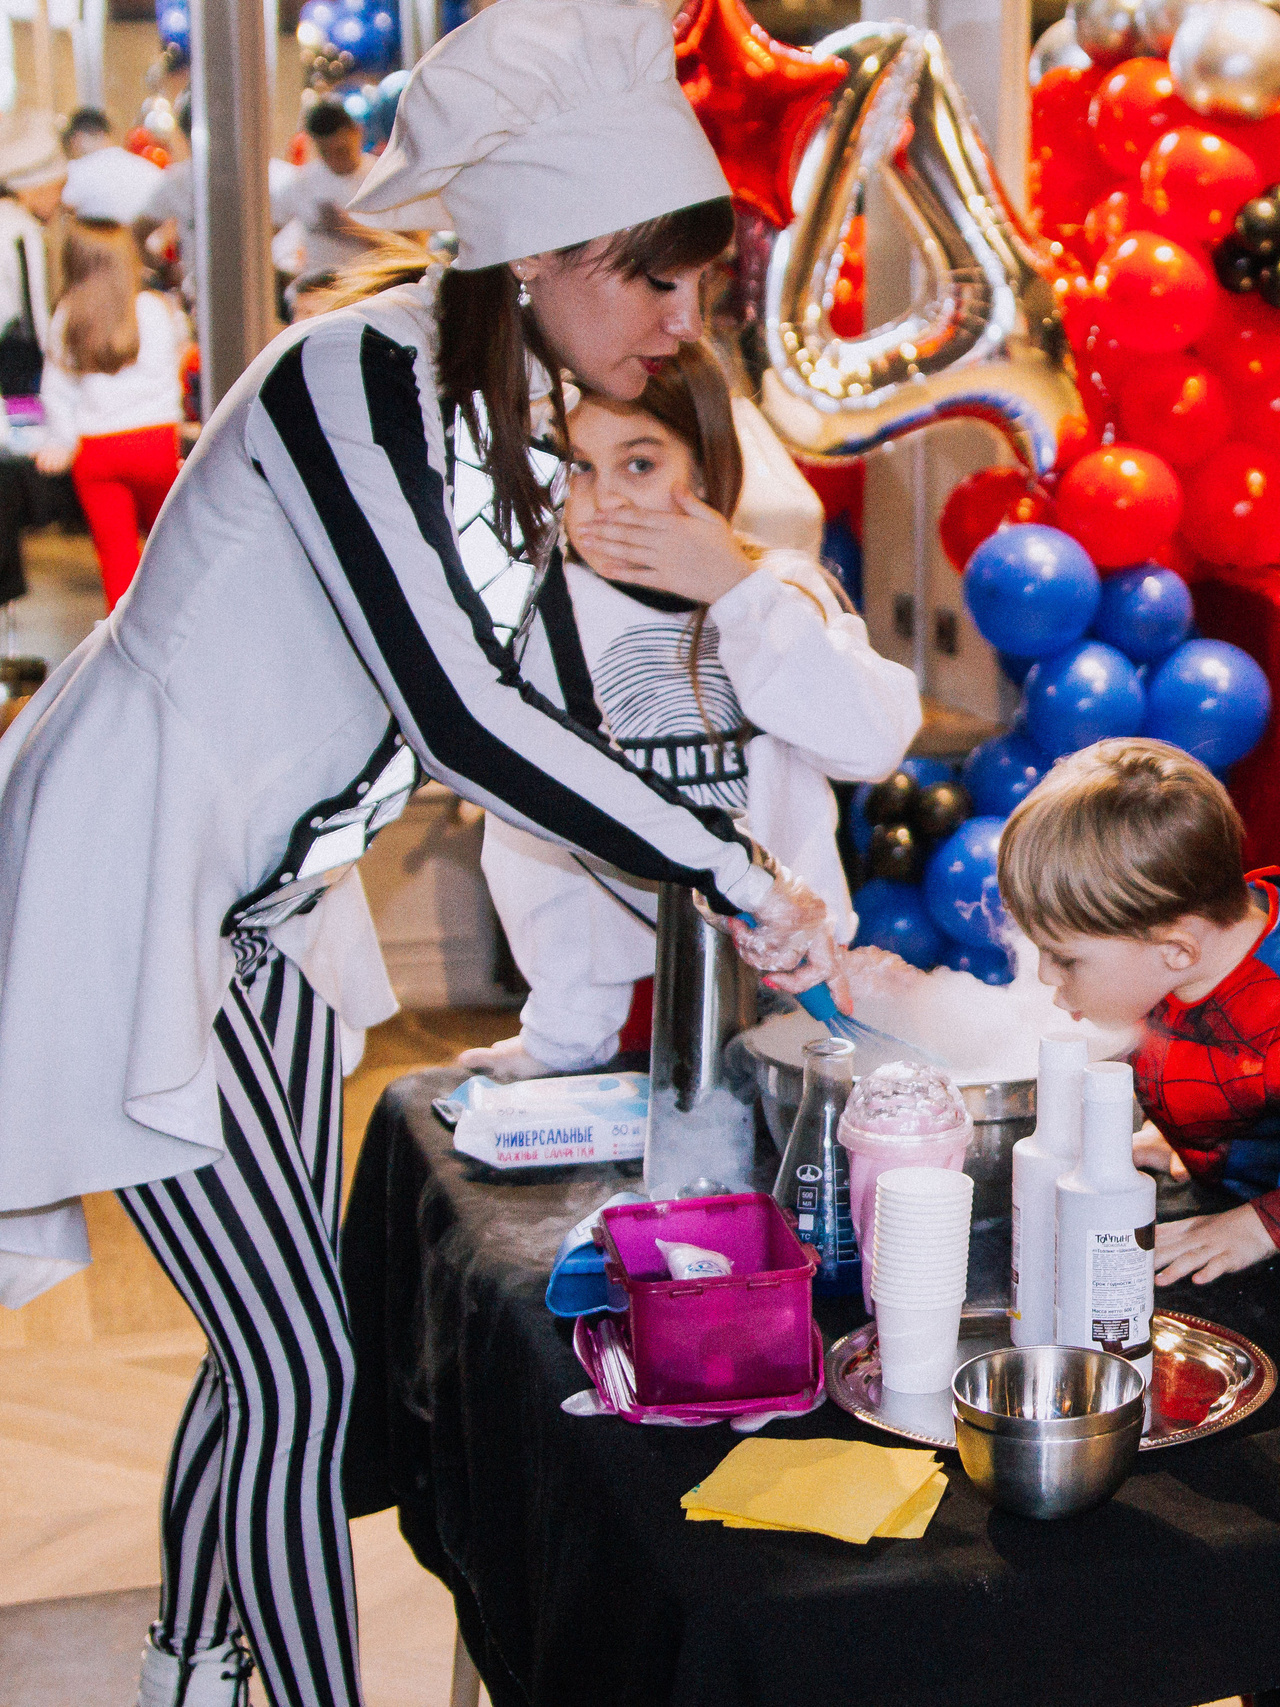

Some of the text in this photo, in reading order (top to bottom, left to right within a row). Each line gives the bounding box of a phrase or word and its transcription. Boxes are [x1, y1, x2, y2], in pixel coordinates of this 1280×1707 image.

[611, 1124, 629, 1136] 80
[494, 1126, 594, 1148] УНИВЕРСАЛЬНЫЕ
[802, 1191, 814, 1199] 500
